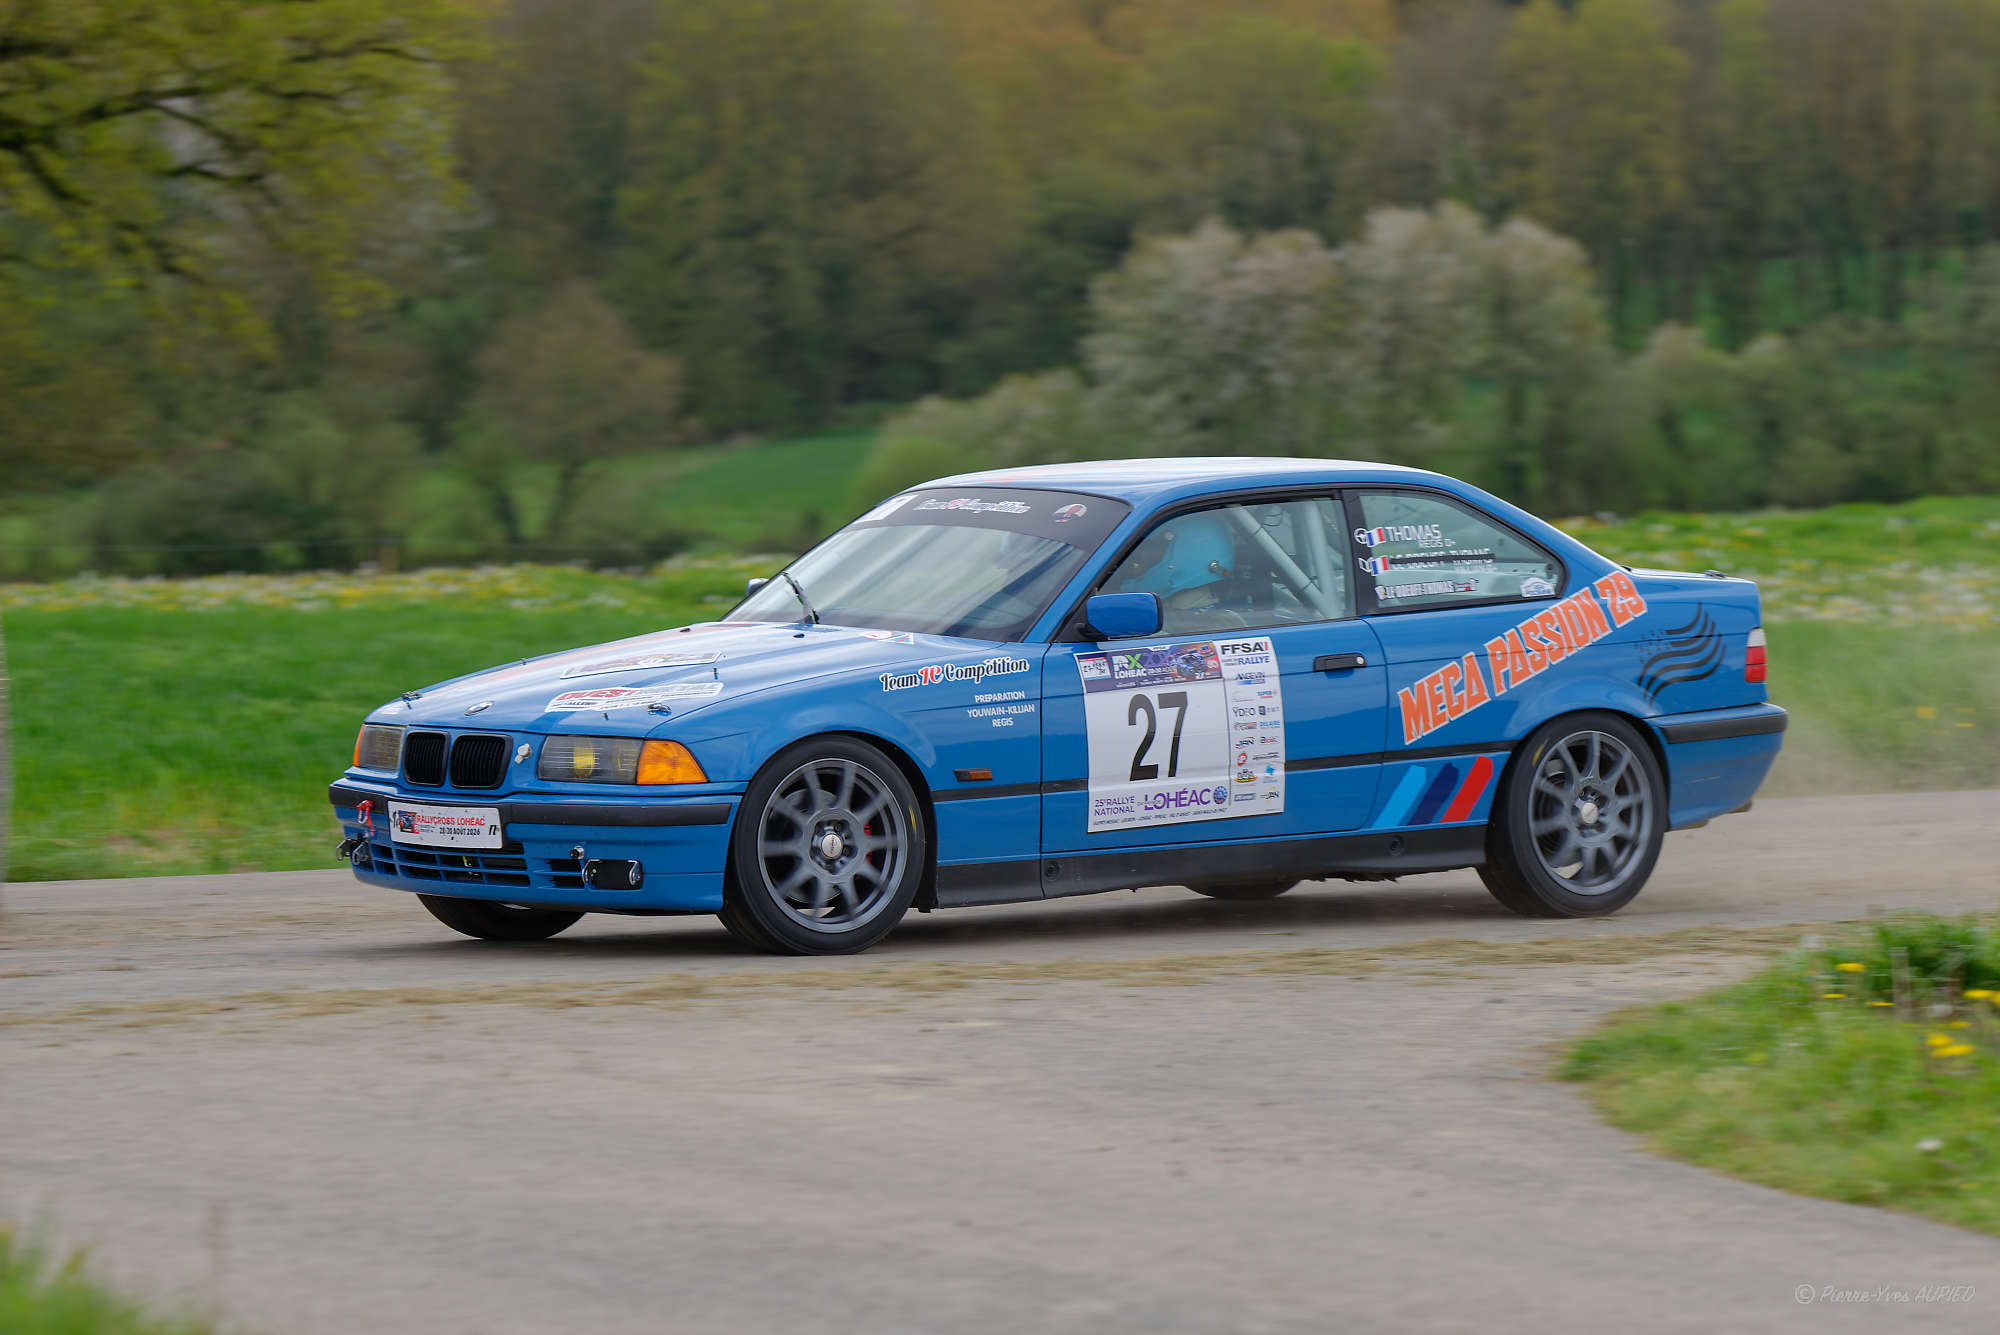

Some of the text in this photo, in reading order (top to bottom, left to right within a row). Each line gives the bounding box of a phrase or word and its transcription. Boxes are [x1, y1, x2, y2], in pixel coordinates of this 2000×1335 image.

[1384, 524, 1442, 542] THOMAS
[1221, 641, 1264, 655] FFSA
[1238, 655, 1270, 665] RALLYE
[1397, 570, 1648, 745] MECA PASSION 29
[880, 673, 920, 692] Team
[975, 690, 1025, 703] PREPARATION
[967, 704, 1035, 718] YOUWAIN-KILLIAN
[992, 717, 1014, 727] REGIS
[1128, 691, 1188, 781] 27
[1107, 796, 1135, 806] RALLYE
[1144, 788, 1211, 811] LOHÉAC
[1094, 805, 1135, 817] NATIONAL
[415, 813, 456, 825] RALLYCROSS
